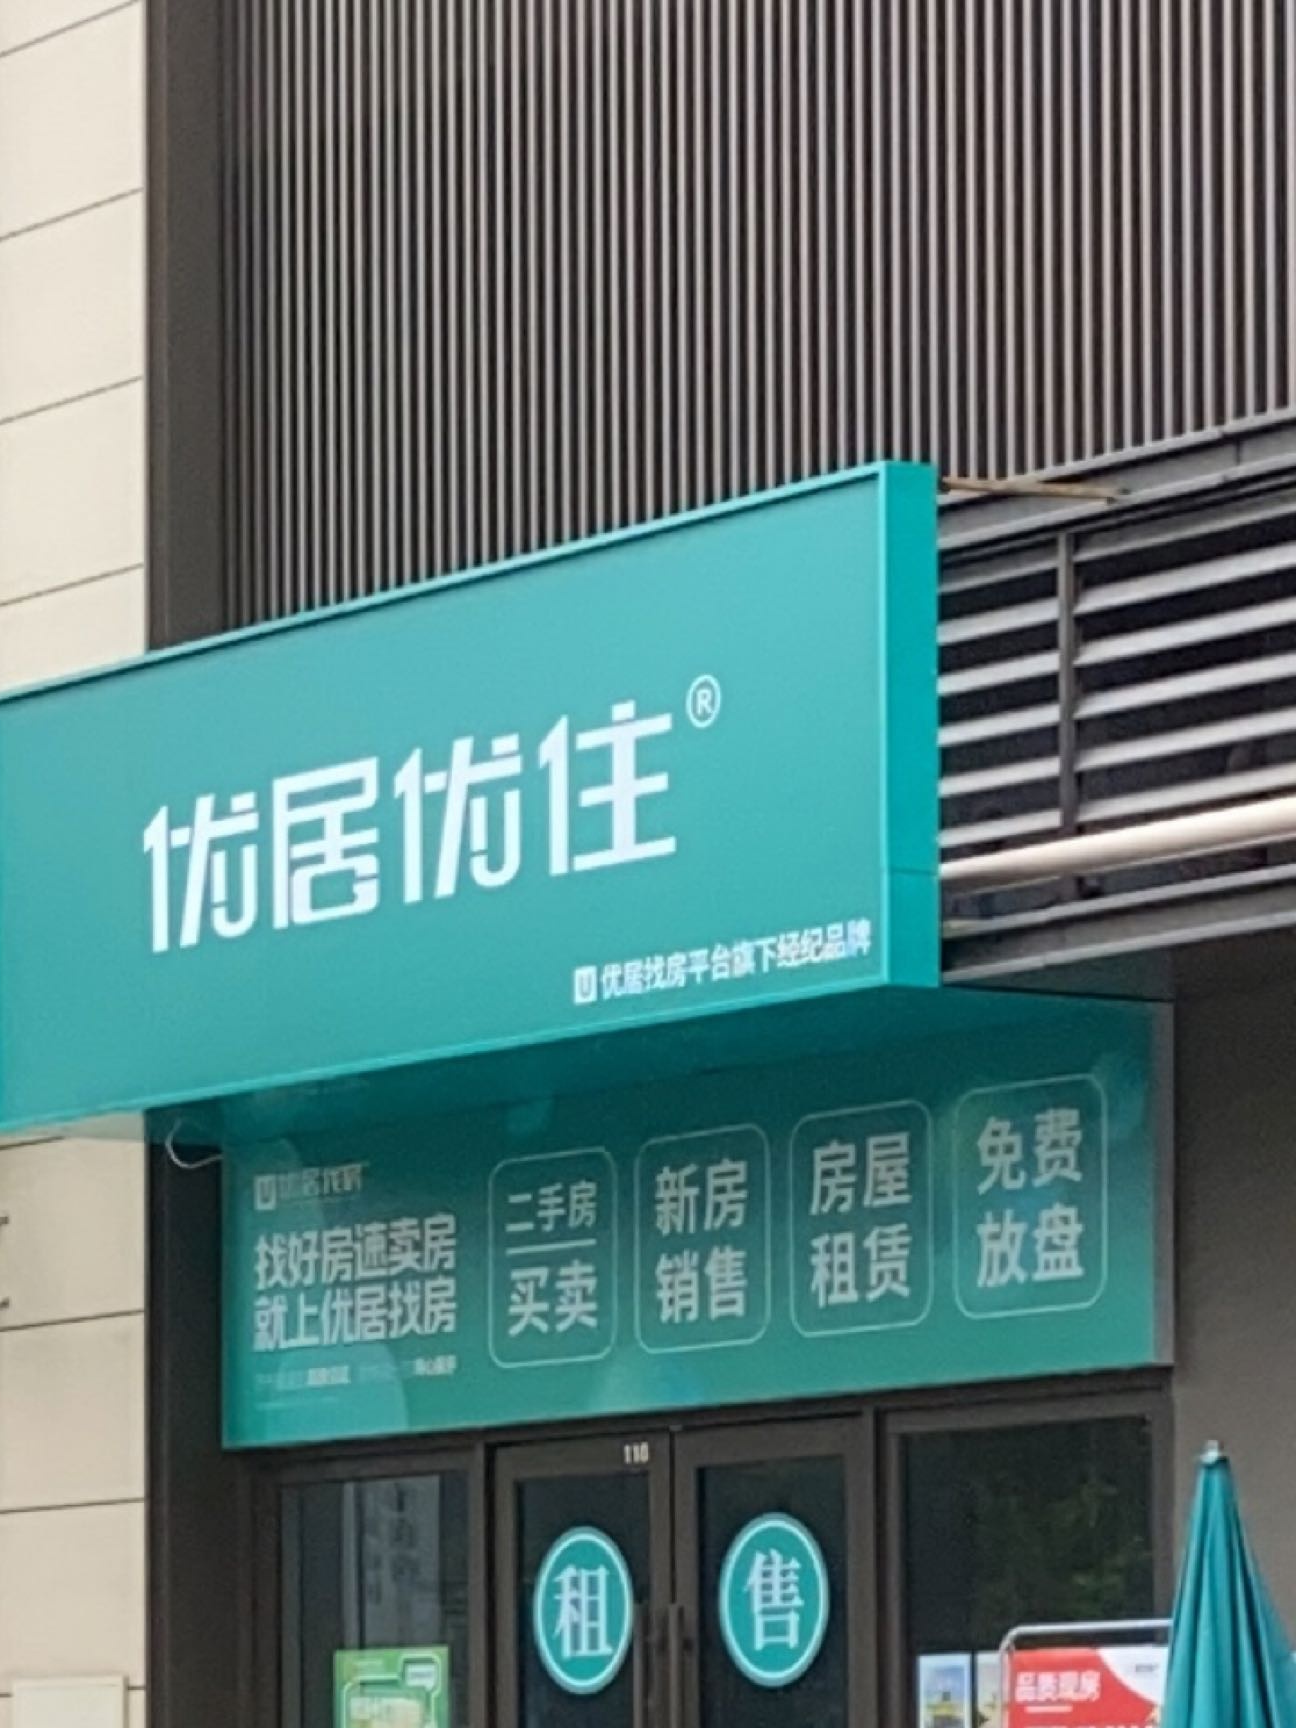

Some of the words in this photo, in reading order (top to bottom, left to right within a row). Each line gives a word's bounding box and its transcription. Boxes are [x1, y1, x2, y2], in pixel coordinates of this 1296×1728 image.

[144, 700, 677, 954] 优居优住
[601, 917, 871, 1001] 优居找房平台旗下经纪品牌
[809, 1131, 912, 1216] 房屋
[977, 1107, 1084, 1195] 免费
[505, 1180, 597, 1233] 二手房
[654, 1158, 749, 1237] 新房
[654, 1246, 749, 1324] 销售
[810, 1223, 911, 1309] 租赁
[977, 1203, 1085, 1288] 放盘
[254, 1274, 457, 1350] 就上优居找房
[508, 1259, 598, 1337] 买卖
[554, 1564, 615, 1661] 租
[744, 1549, 804, 1652] 售
